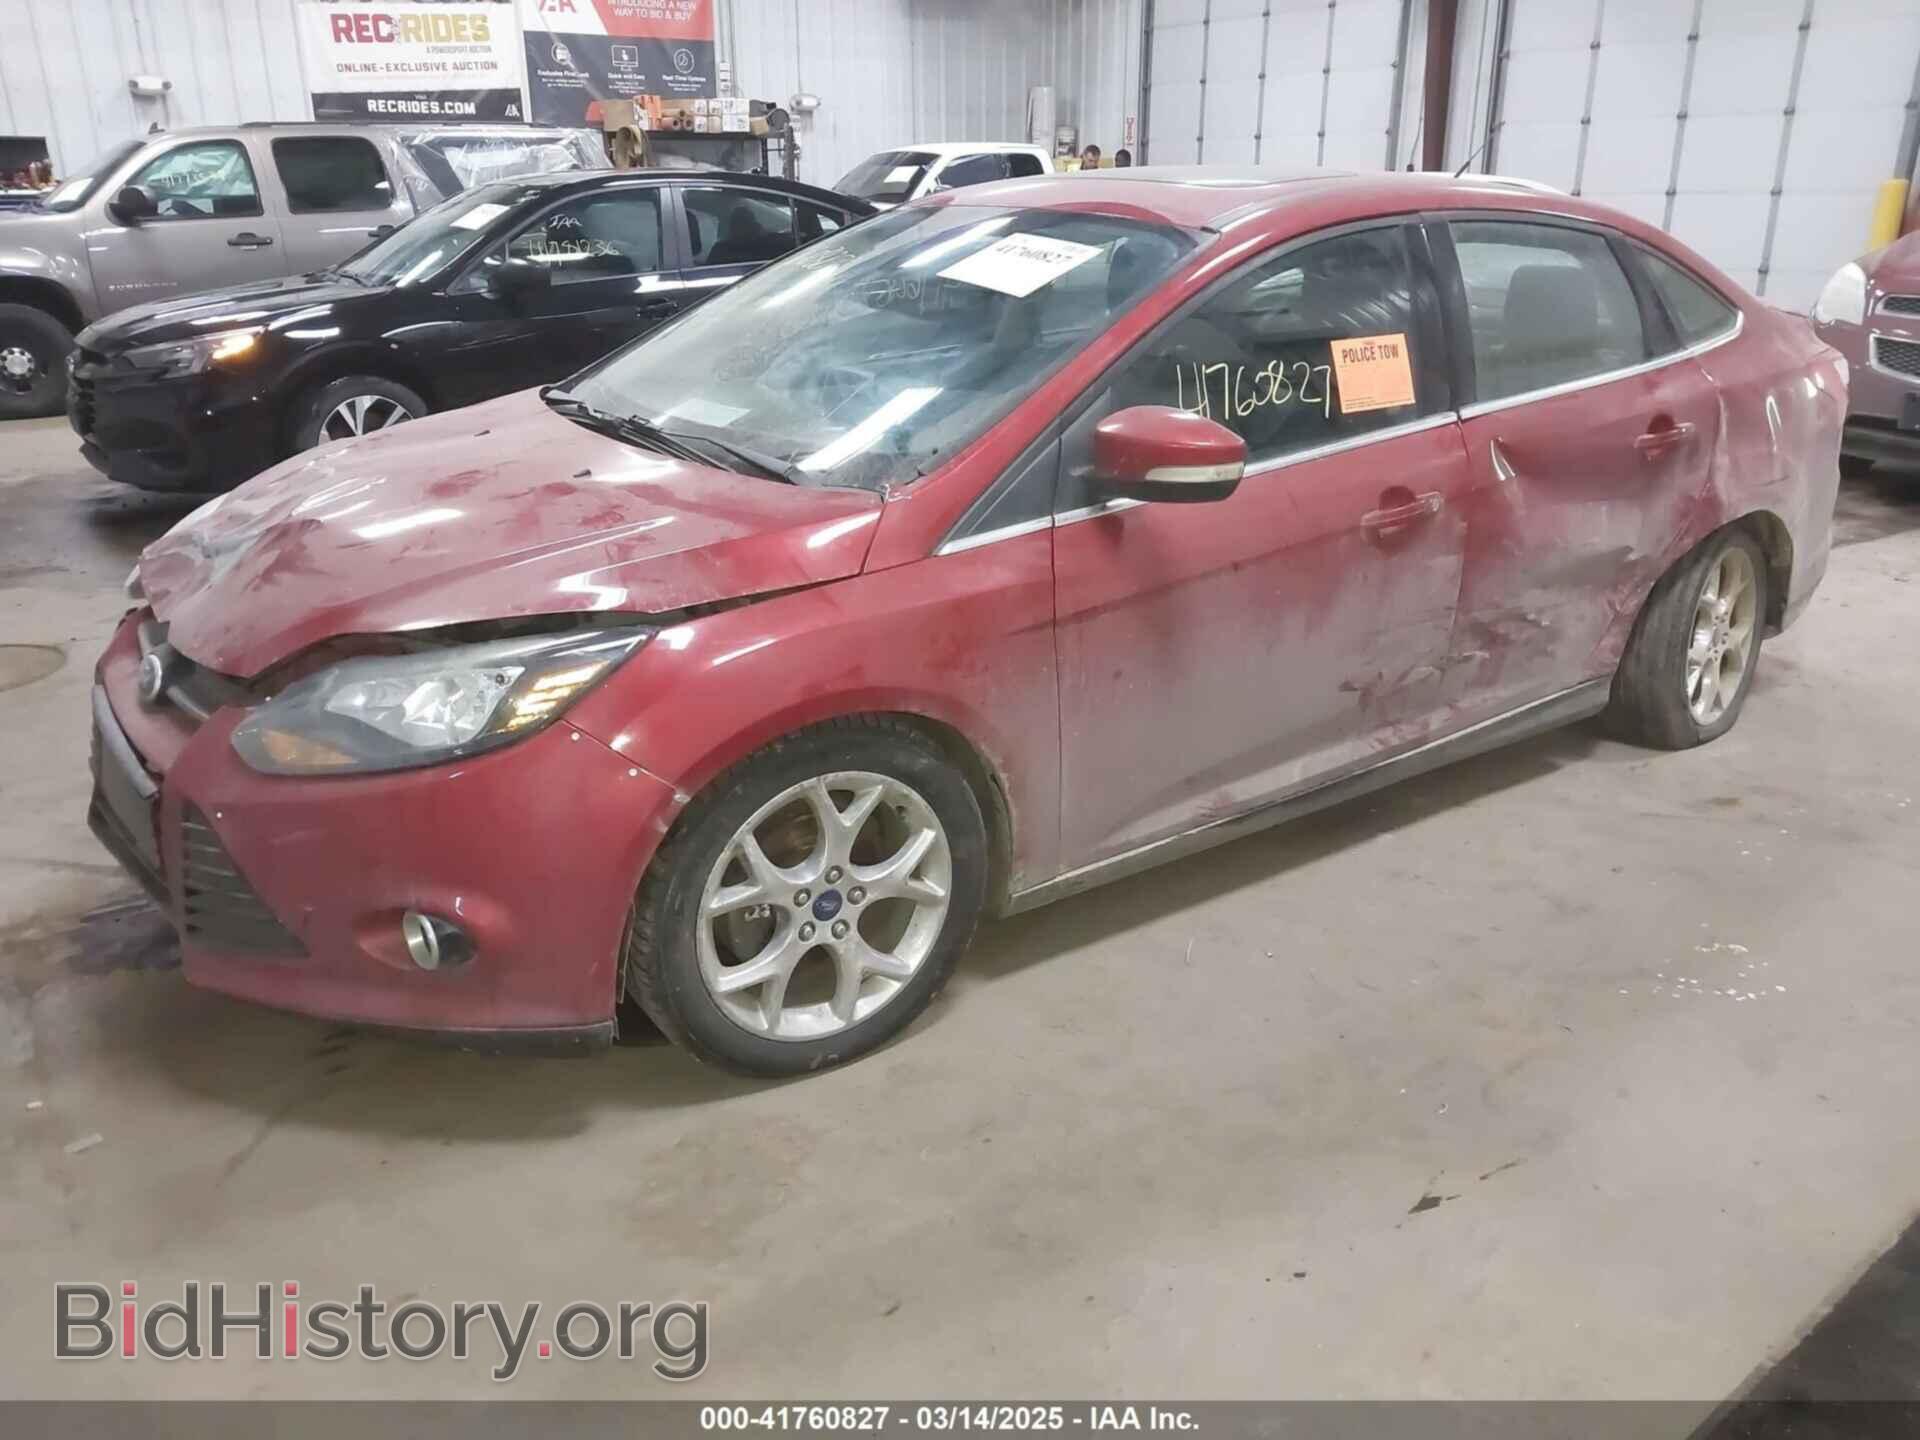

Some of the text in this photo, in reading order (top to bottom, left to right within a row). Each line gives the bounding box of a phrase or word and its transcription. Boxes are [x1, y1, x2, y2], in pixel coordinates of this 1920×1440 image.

[452, 61, 498, 71] AUCTION
[367, 100, 476, 115] RECRIDES.COM
[1342, 344, 1400, 364] POLICE TOW
[1176, 360, 1331, 420] 41760827
